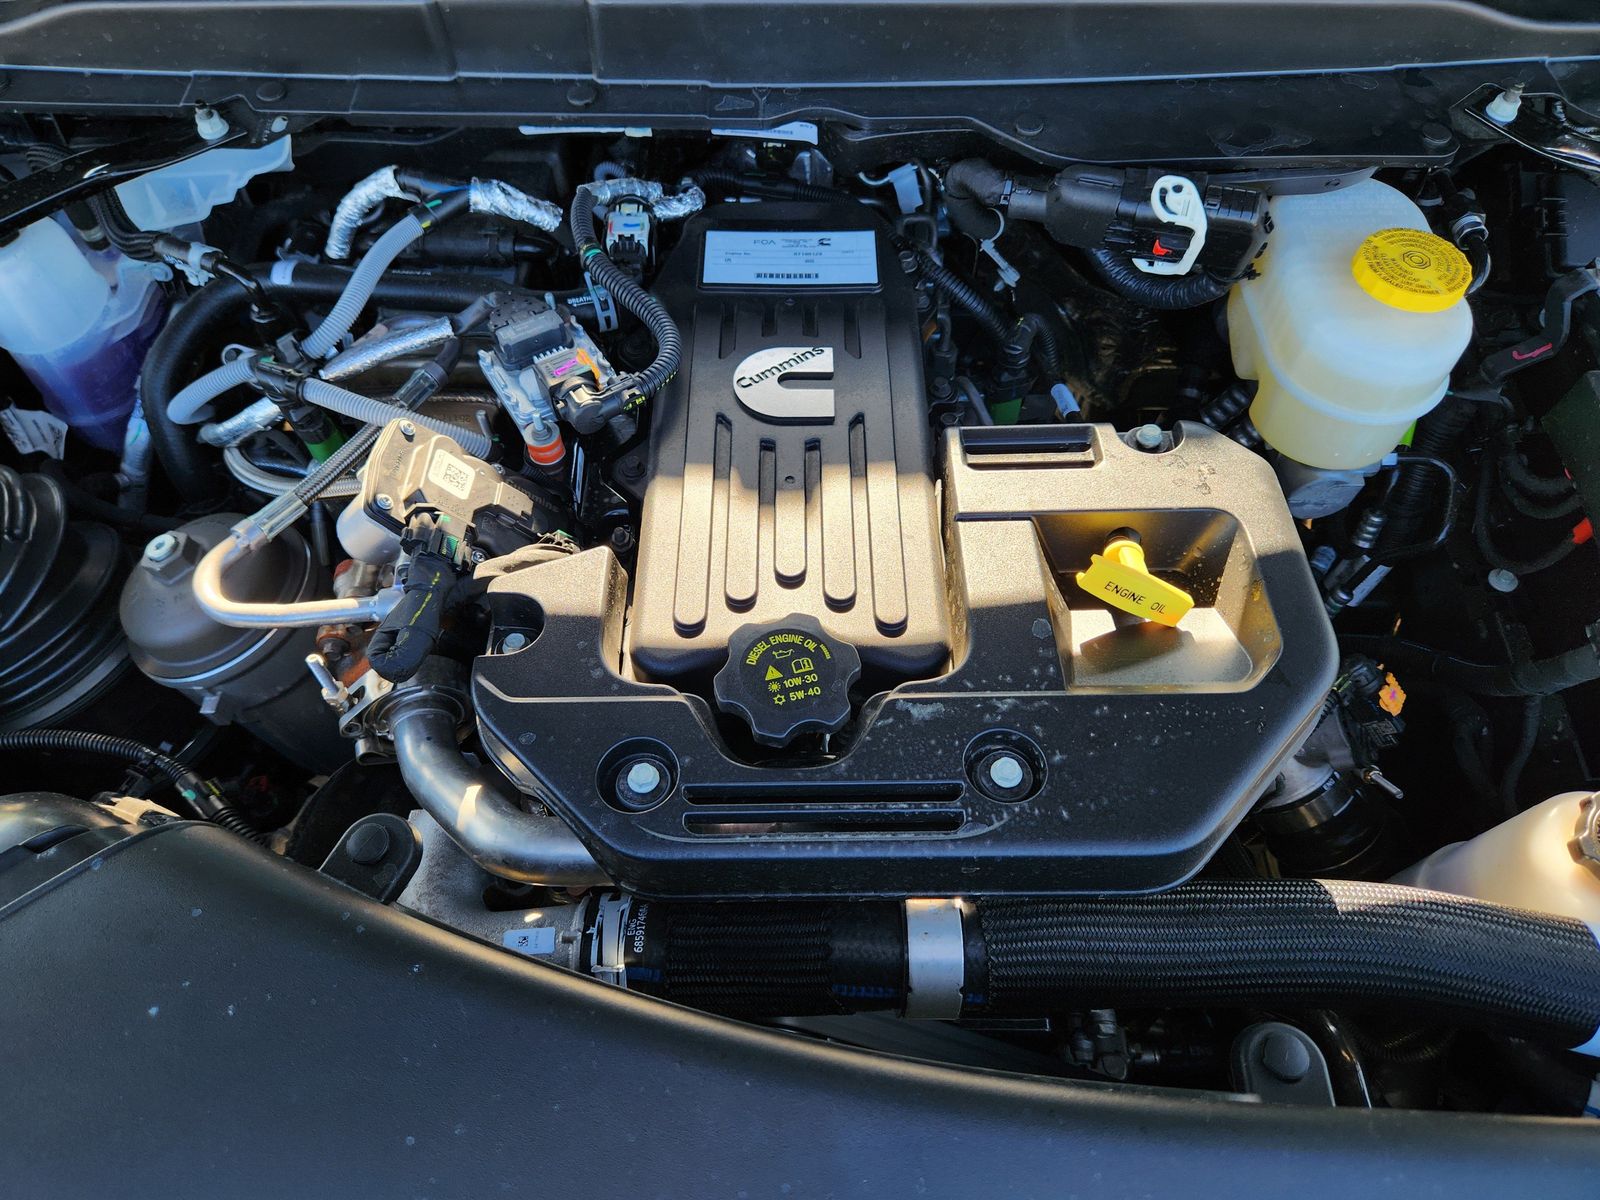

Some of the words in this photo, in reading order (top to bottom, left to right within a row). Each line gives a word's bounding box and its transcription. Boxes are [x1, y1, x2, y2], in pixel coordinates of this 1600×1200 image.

[736, 346, 825, 389] Cummins
[1104, 581, 1146, 606] ENGINE
[1150, 602, 1167, 615] OIL
[746, 640, 771, 666] DIESEL
[769, 633, 804, 646] ENGINE
[803, 639, 818, 653] OIL
[783, 673, 819, 689] 10W-30
[789, 686, 821, 702] 5W-40
[627, 918, 637, 936] ENG
